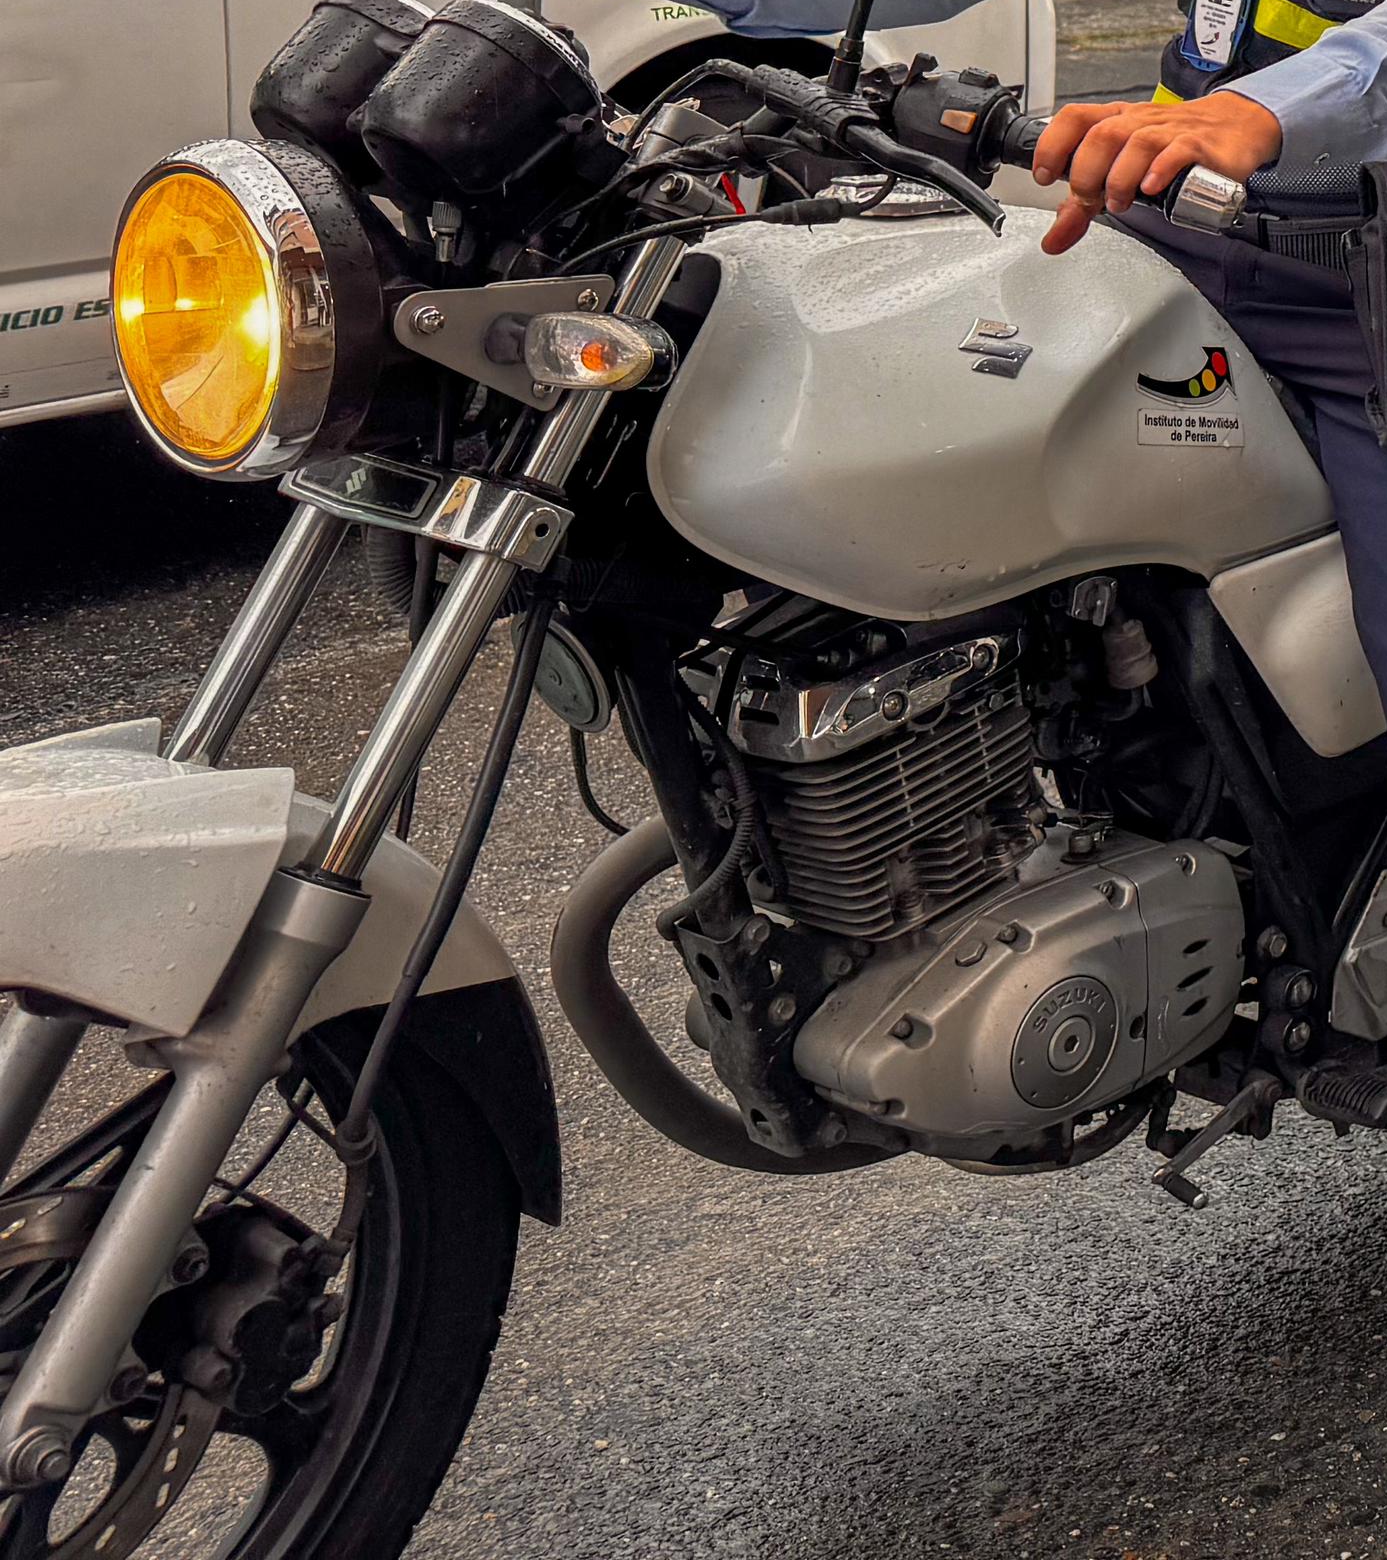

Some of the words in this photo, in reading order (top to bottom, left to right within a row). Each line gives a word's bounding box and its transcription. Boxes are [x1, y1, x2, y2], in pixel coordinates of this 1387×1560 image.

[651, 5, 710, 21] TRAN
[73, 298, 112, 321] ES
[1144, 413, 1183, 428] Instituto
[1184, 416, 1197, 428] de
[1198, 416, 1240, 430] Movilidad
[1170, 430, 1182, 442] de
[1184, 430, 1217, 443] Pereira
[1033, 986, 1107, 1034] SUZUKI
